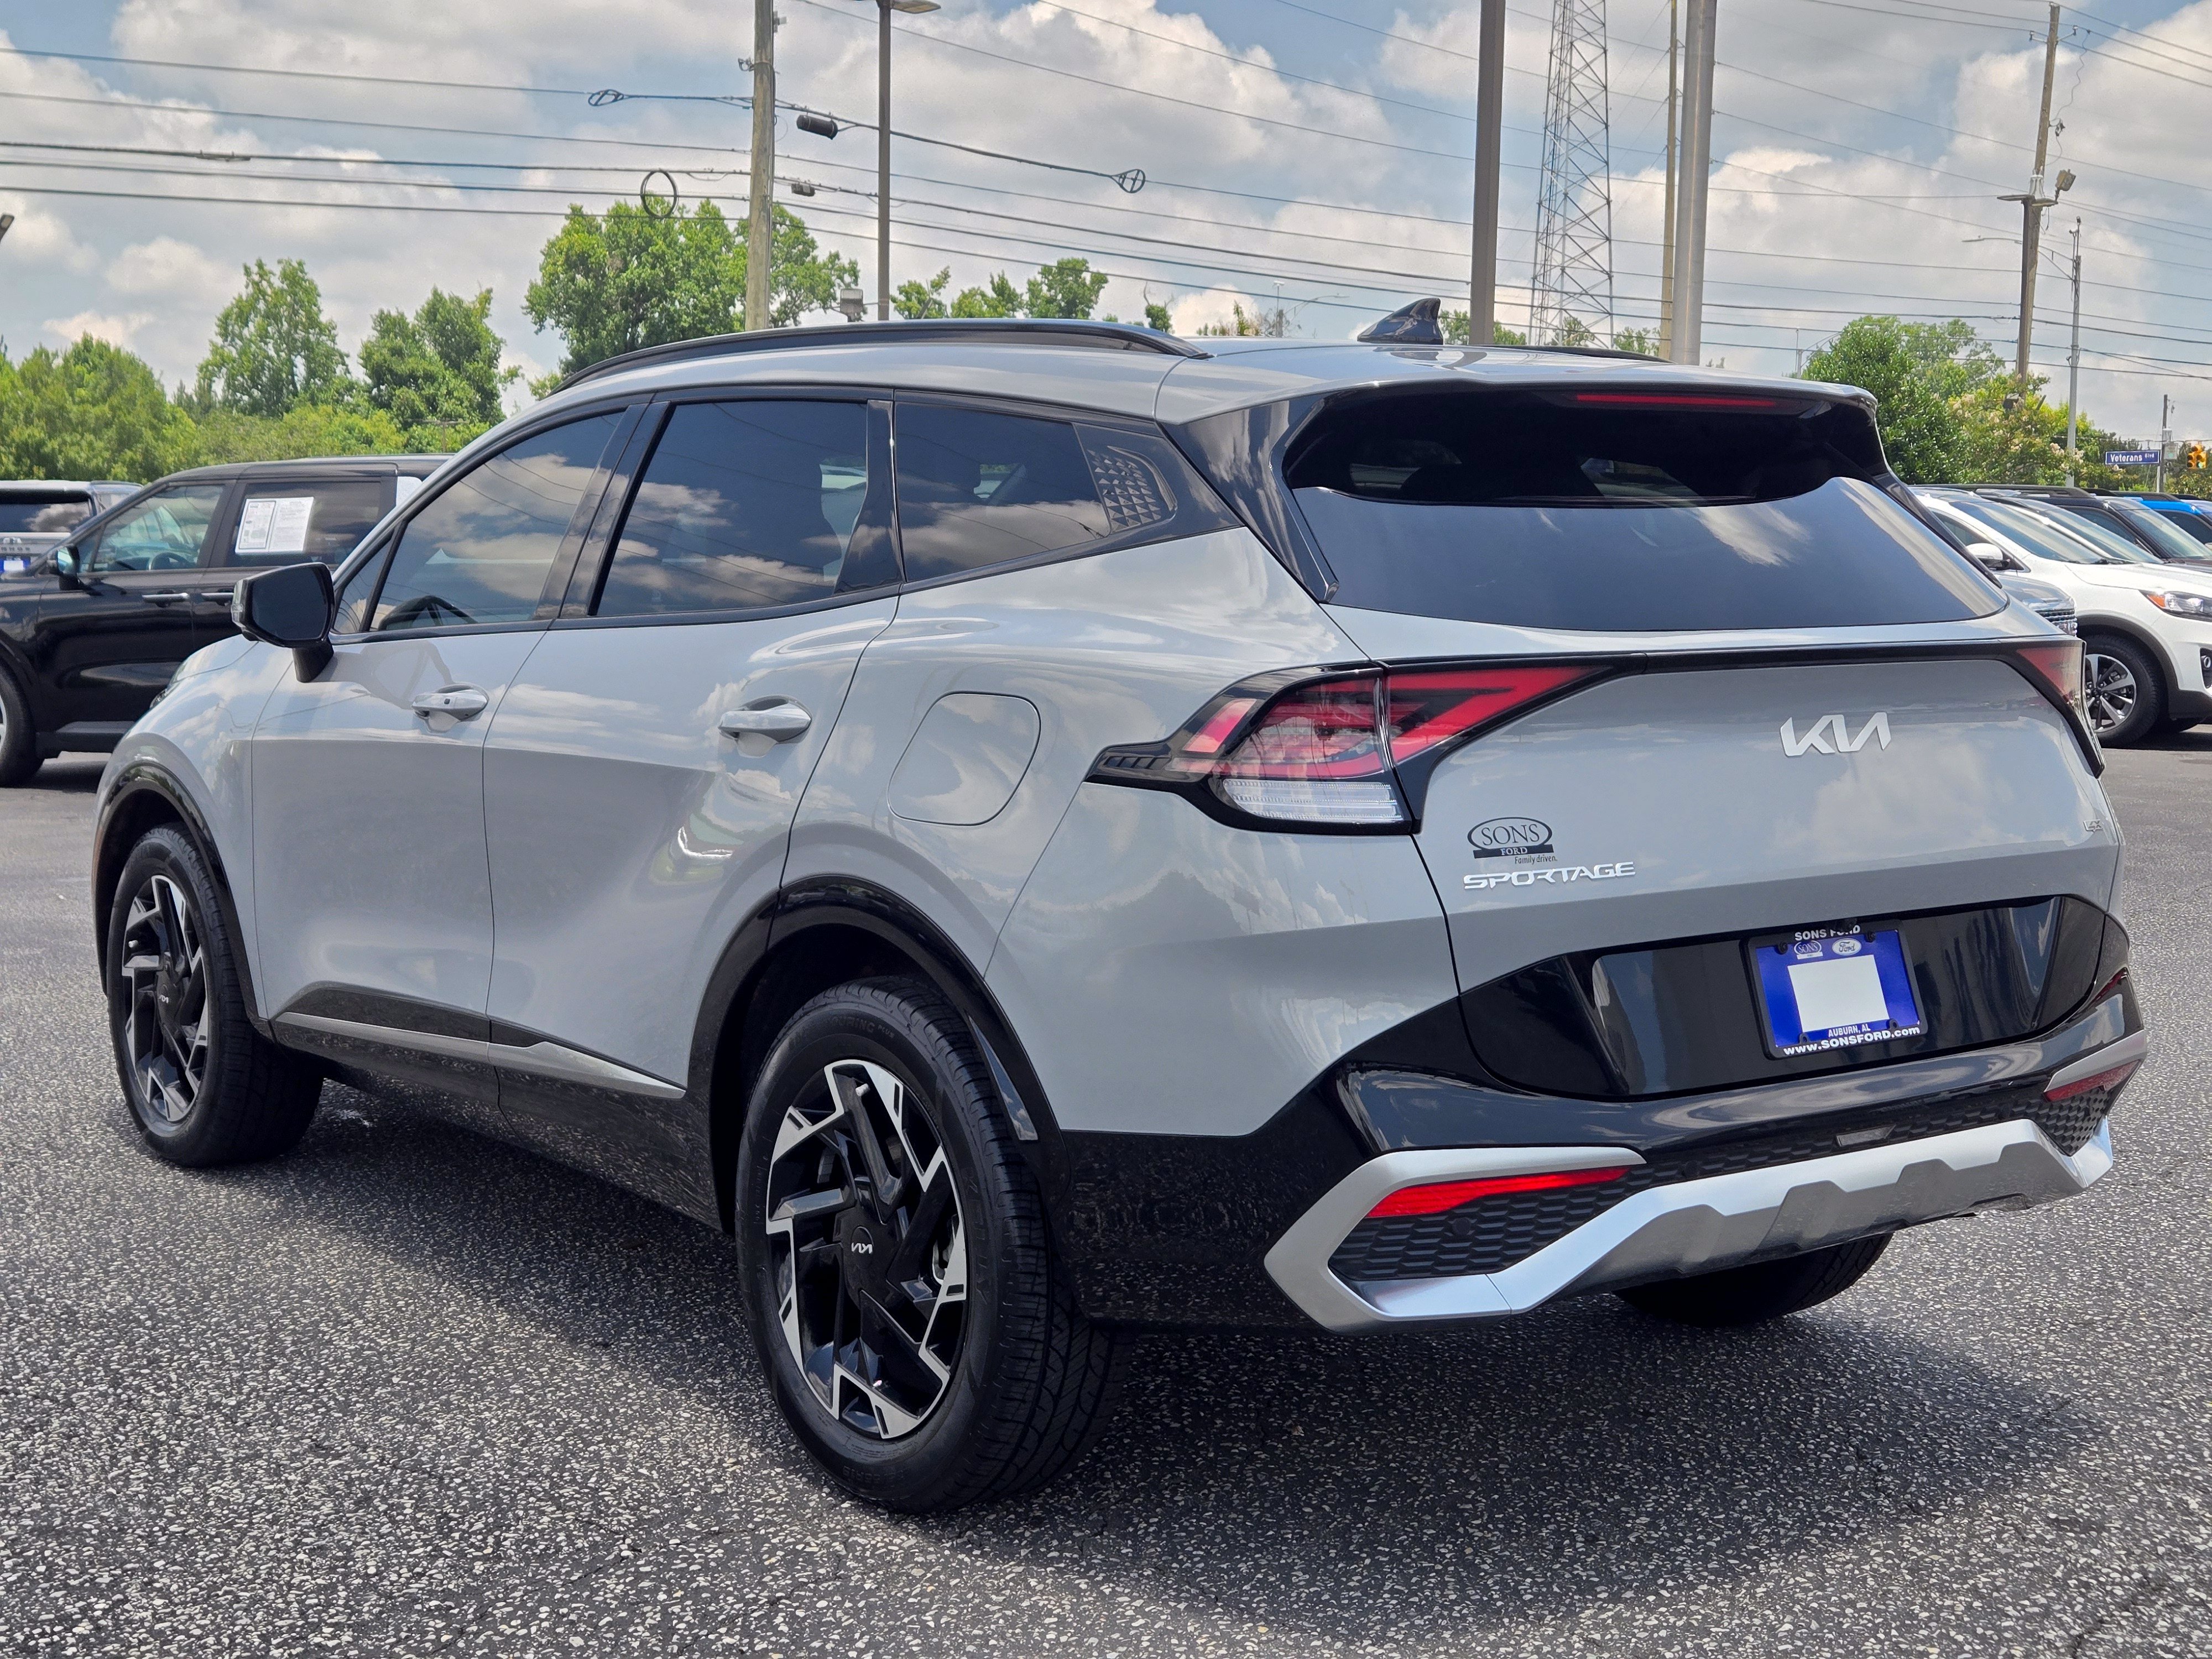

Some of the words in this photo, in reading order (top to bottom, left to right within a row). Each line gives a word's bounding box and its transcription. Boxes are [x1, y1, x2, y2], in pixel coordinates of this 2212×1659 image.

[2110, 453, 2143, 462] Veterans
[1780, 712, 1892, 757] KIA
[1481, 823, 1540, 846] SONS
[1501, 847, 1528, 855] FORD
[1515, 855, 1535, 865] Family
[1463, 861, 1636, 889] SPORTAGE
[1794, 929, 1827, 941] SONS
[1830, 925, 1860, 937] FD
[1798, 942, 1818, 953] SONS
[1839, 941, 1856, 952] Ford
[1828, 1025, 1861, 1038] AUBURN,
[1783, 1026, 1921, 1056] www.SONSFORD.com
